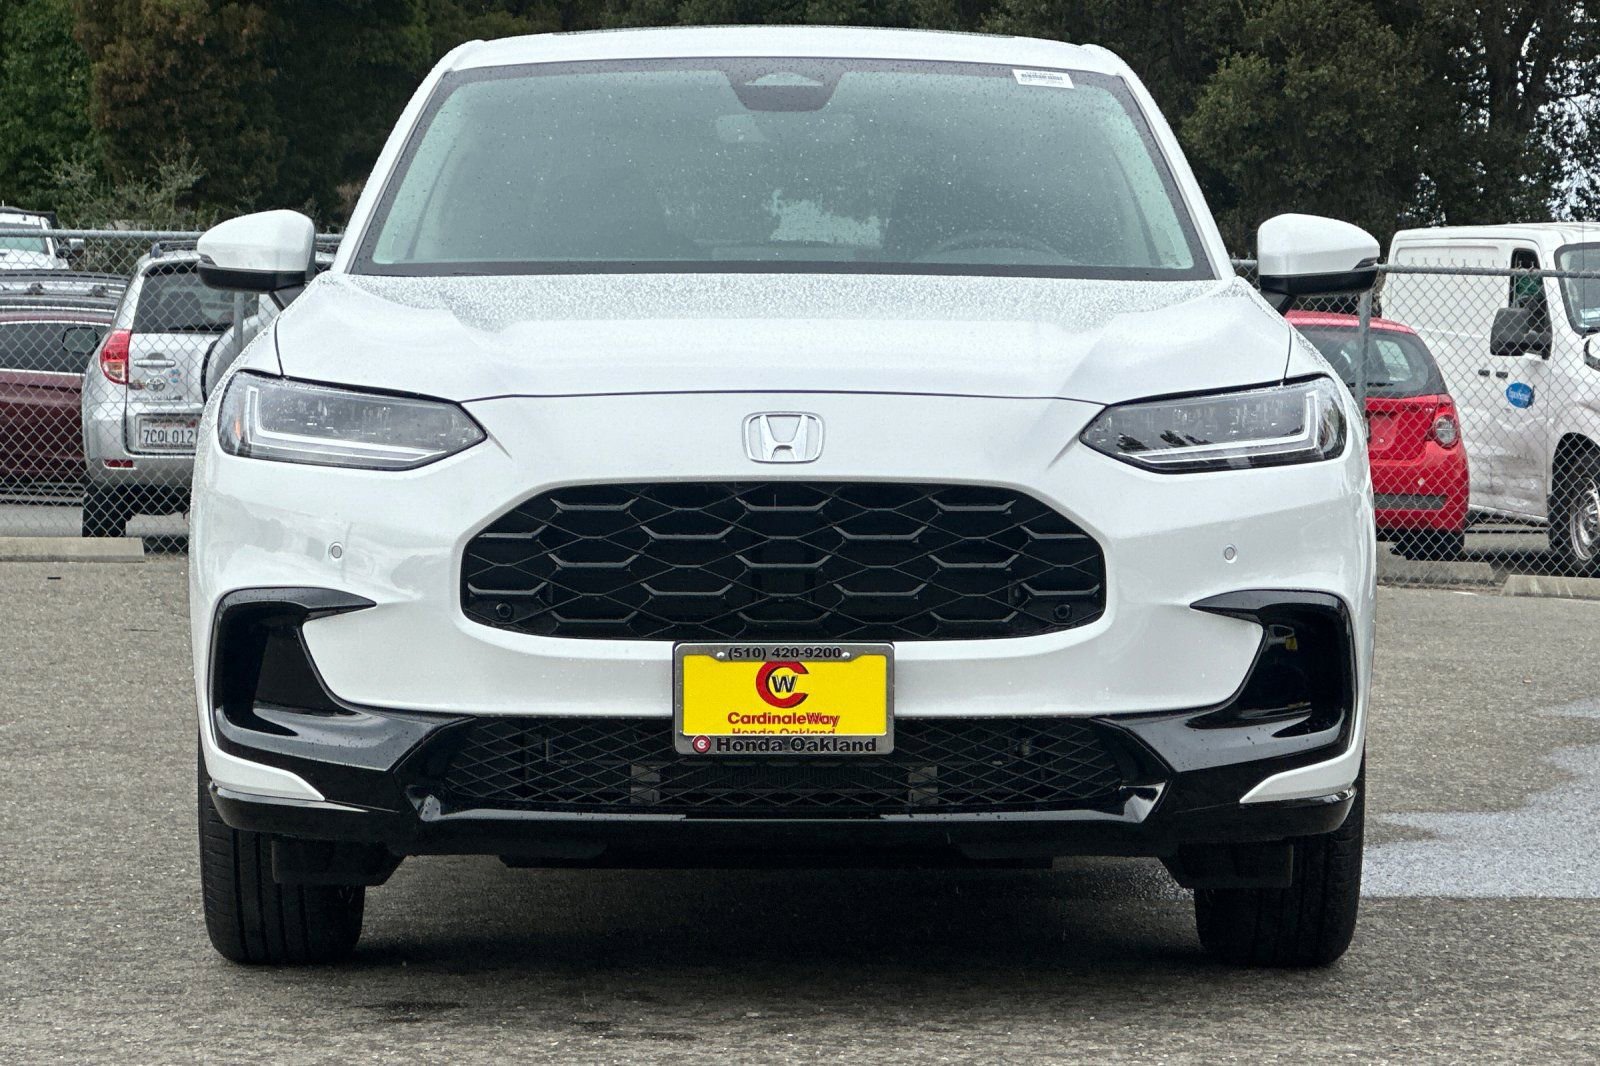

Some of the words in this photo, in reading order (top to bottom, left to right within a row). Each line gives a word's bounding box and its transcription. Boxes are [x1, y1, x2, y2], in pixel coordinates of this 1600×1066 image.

[728, 647, 767, 660] (510)
[771, 647, 842, 659] 420-9200
[727, 712, 840, 727] CardinaleWay
[716, 738, 783, 752] Honda
[790, 737, 877, 752] Oakland
